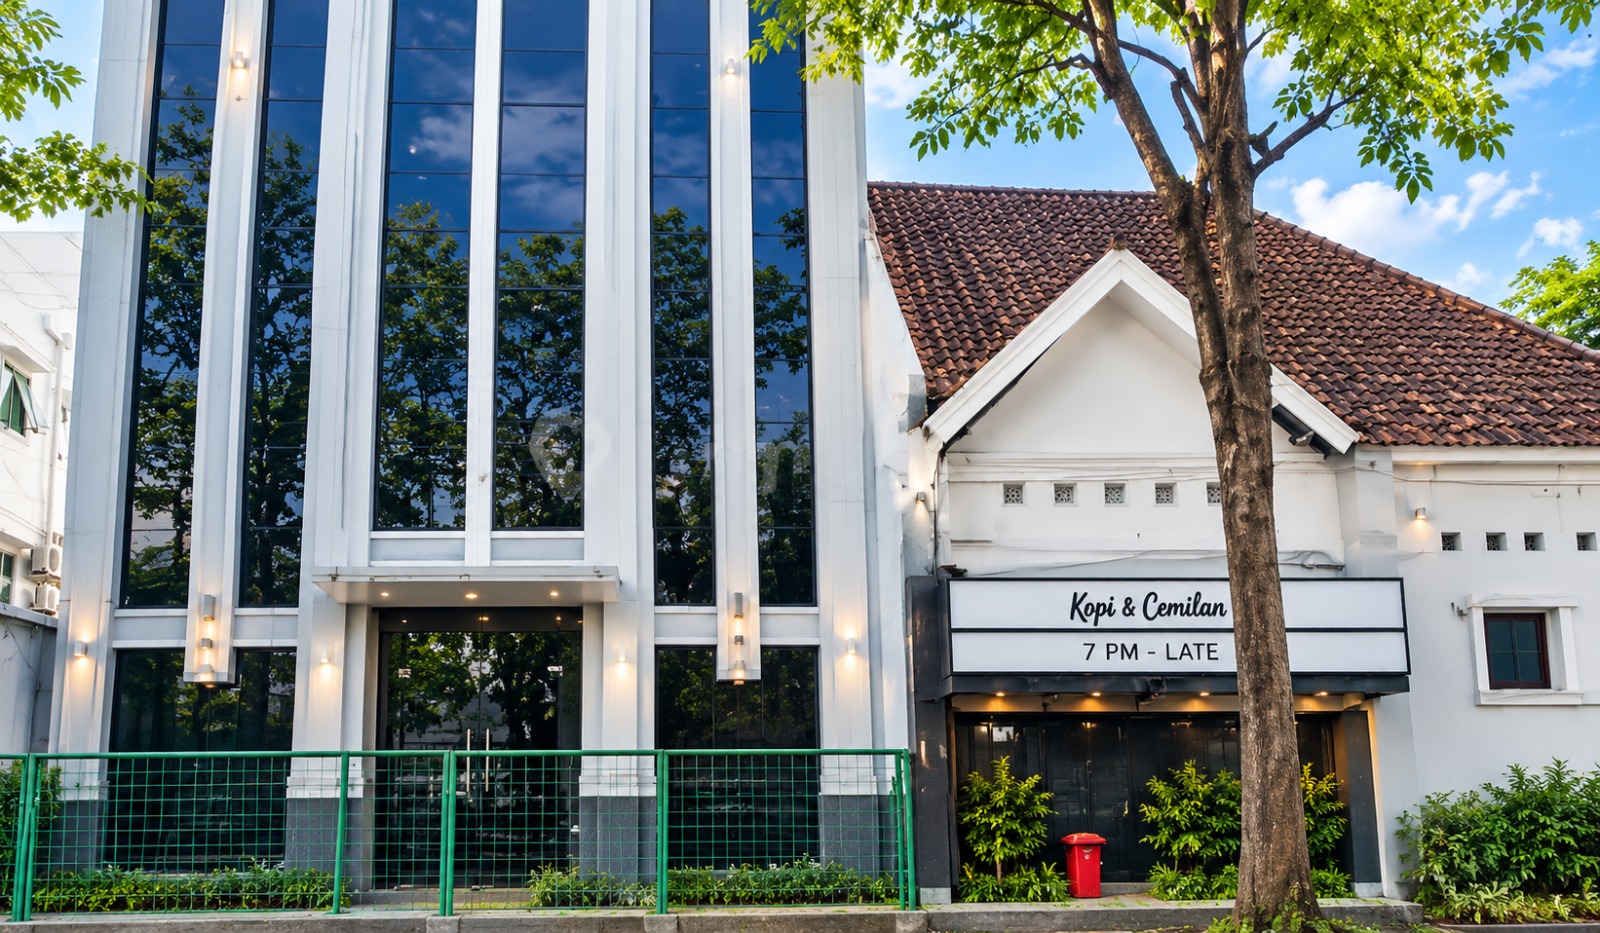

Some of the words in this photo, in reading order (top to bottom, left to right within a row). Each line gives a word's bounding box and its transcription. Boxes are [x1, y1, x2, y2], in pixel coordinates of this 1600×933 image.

[1070, 592, 1116, 627] Kopi
[1122, 596, 1136, 617] &
[1142, 591, 1227, 621] Cemilan
[1083, 643, 1096, 661] 7
[1106, 643, 1139, 661] PM
[1166, 643, 1219, 661] LATE
